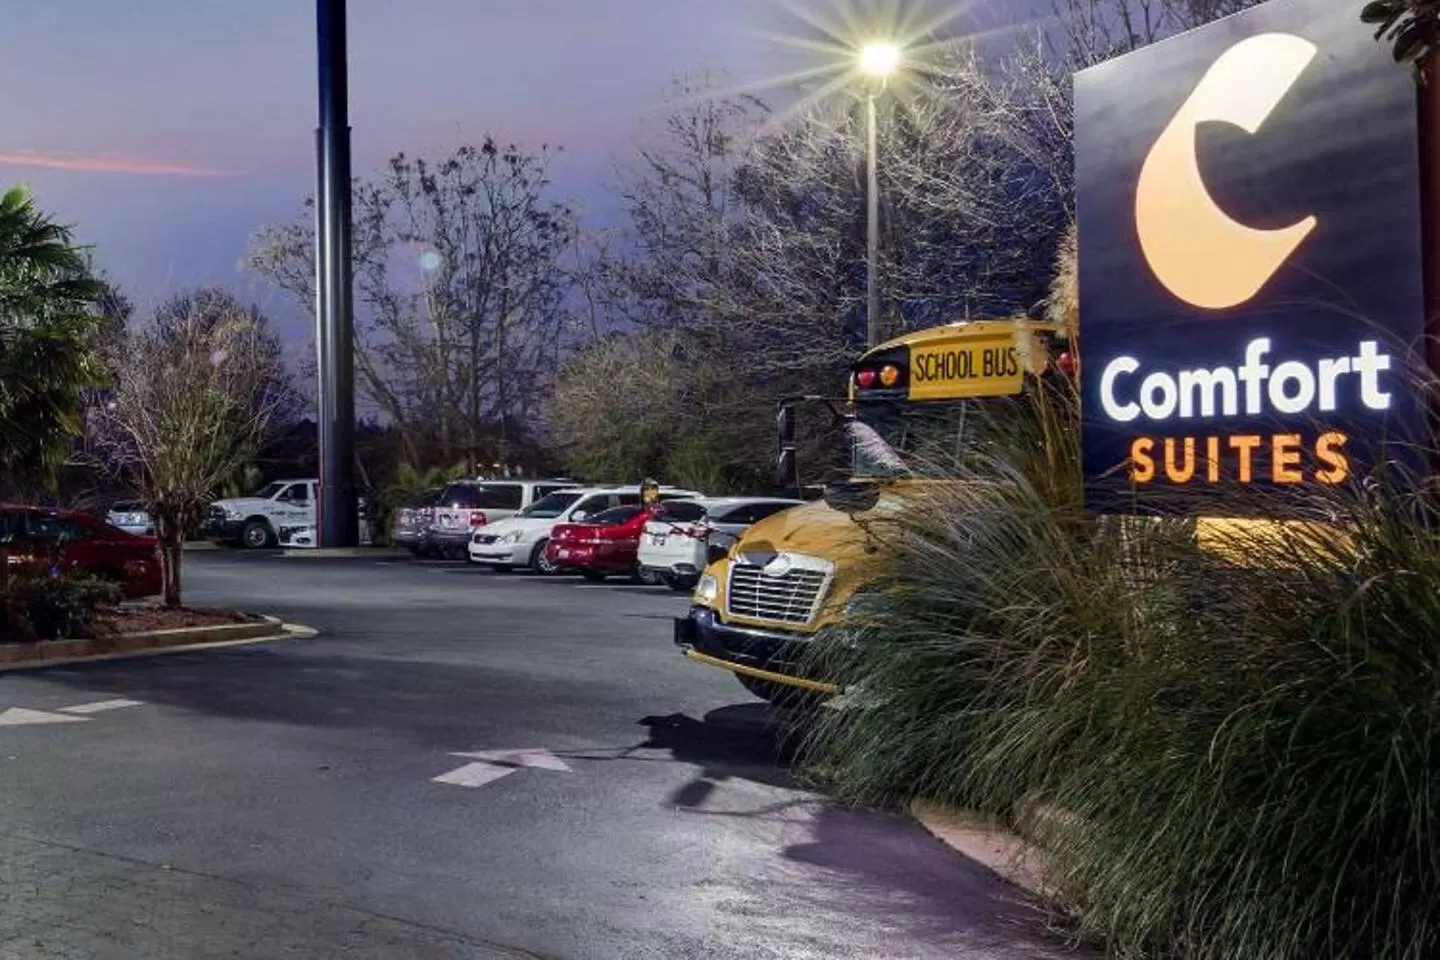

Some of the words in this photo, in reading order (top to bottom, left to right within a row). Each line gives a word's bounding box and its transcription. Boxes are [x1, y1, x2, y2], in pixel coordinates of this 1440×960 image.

[914, 350, 979, 381] SCHOOL
[982, 346, 1018, 377] BUS
[1100, 336, 1392, 423] Comfort
[1129, 431, 1350, 484] SUITES
